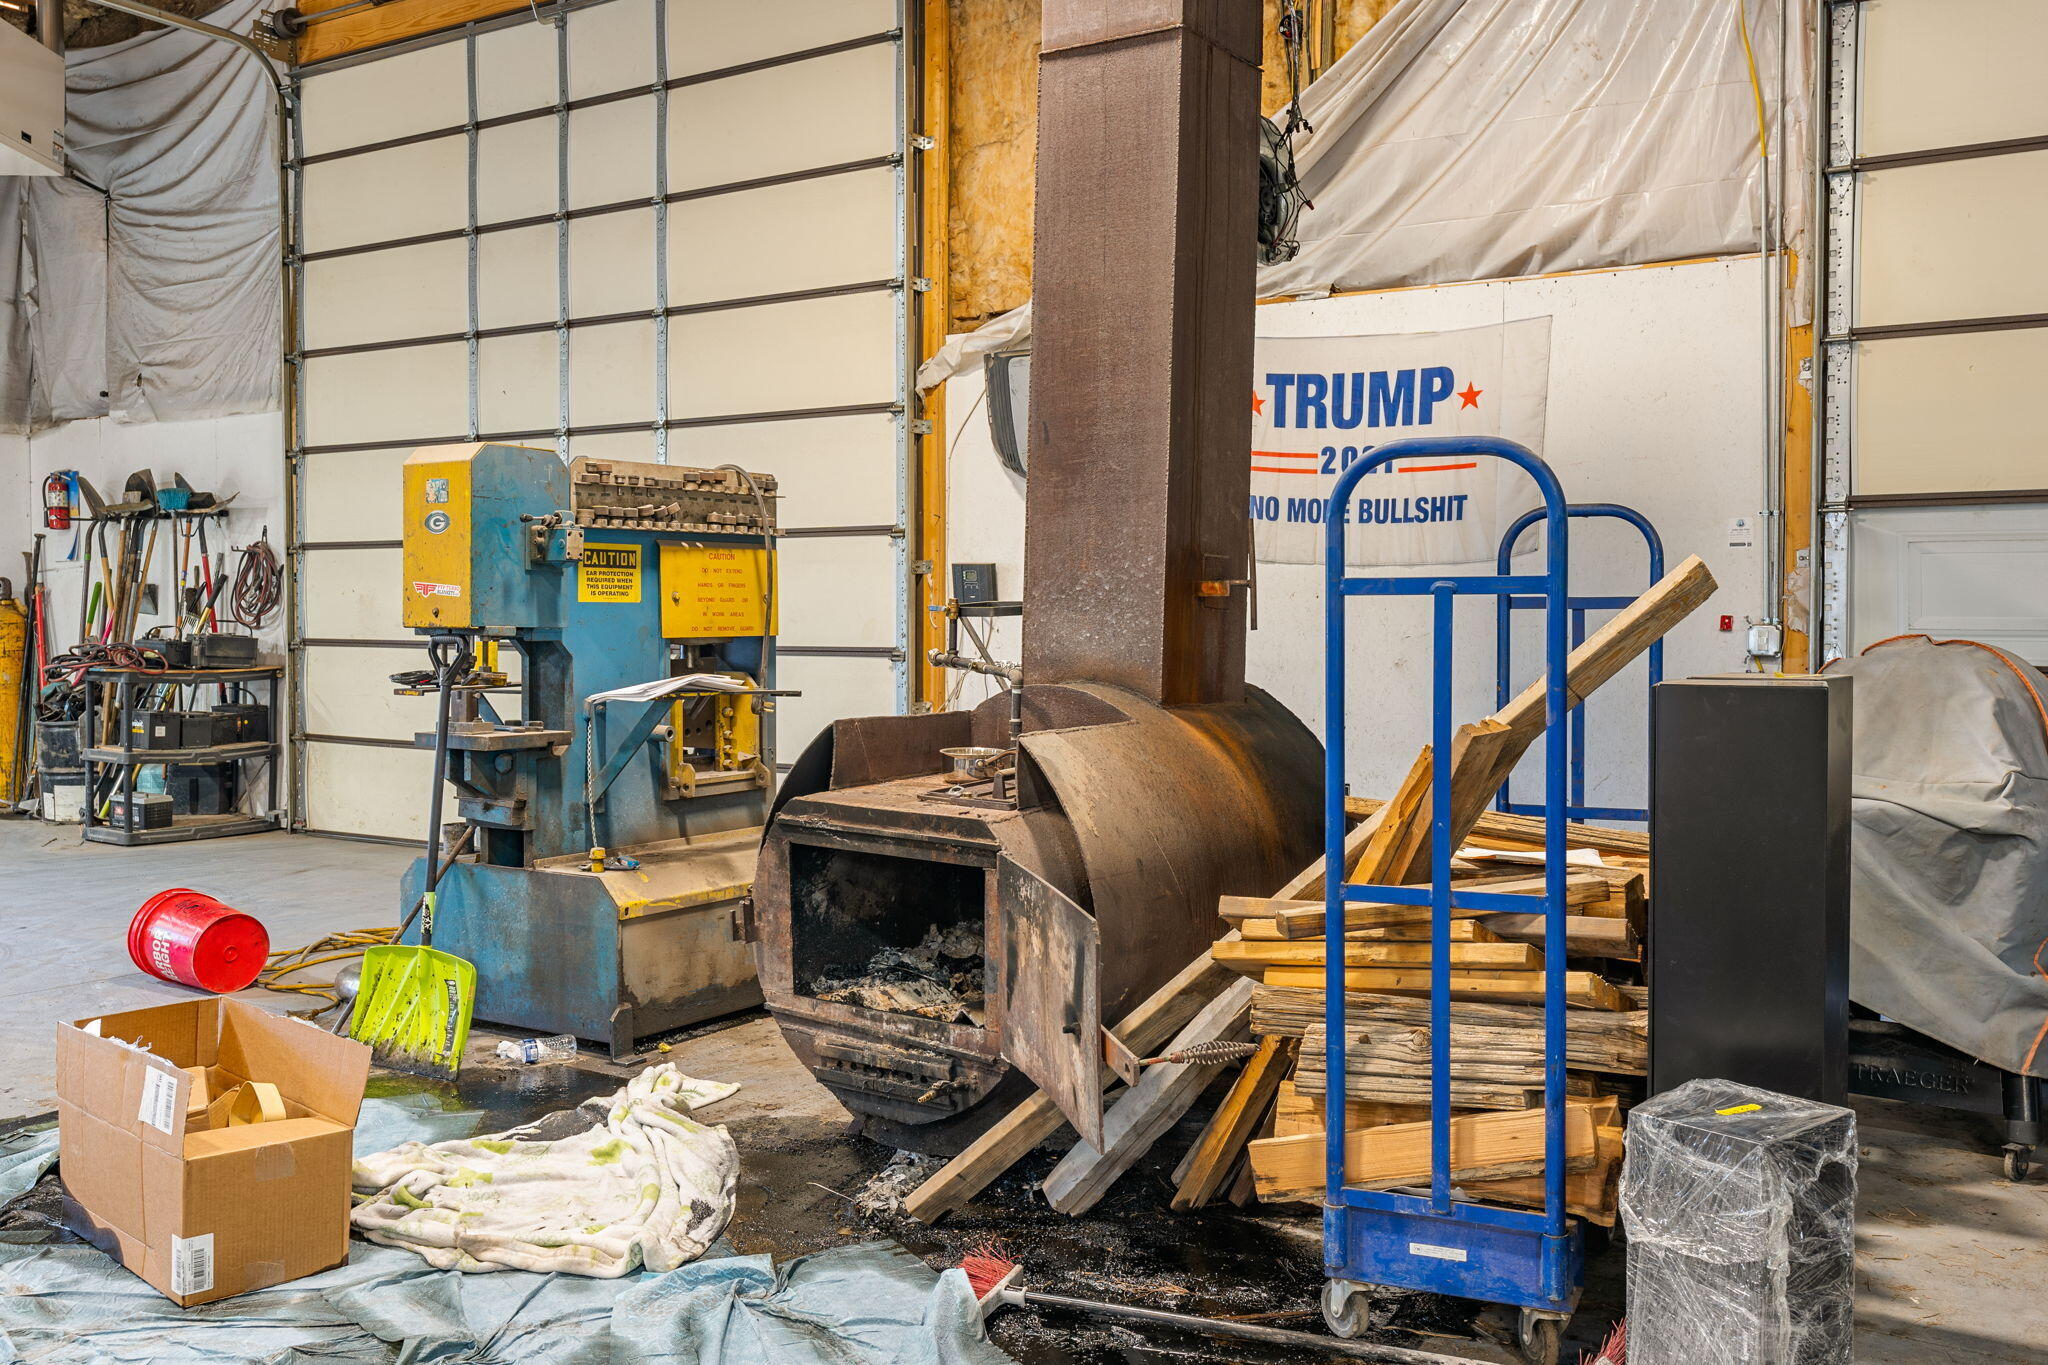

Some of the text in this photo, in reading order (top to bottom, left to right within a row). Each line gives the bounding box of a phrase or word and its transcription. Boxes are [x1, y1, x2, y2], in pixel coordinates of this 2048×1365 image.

[1265, 366, 1455, 429] TRUMP
[1249, 495, 1280, 521] NO
[1358, 494, 1468, 524] BULLSHIT
[584, 551, 636, 566] CAUTION
[708, 552, 736, 560] CAUTION
[1857, 1063, 1969, 1094] TRAEGER
